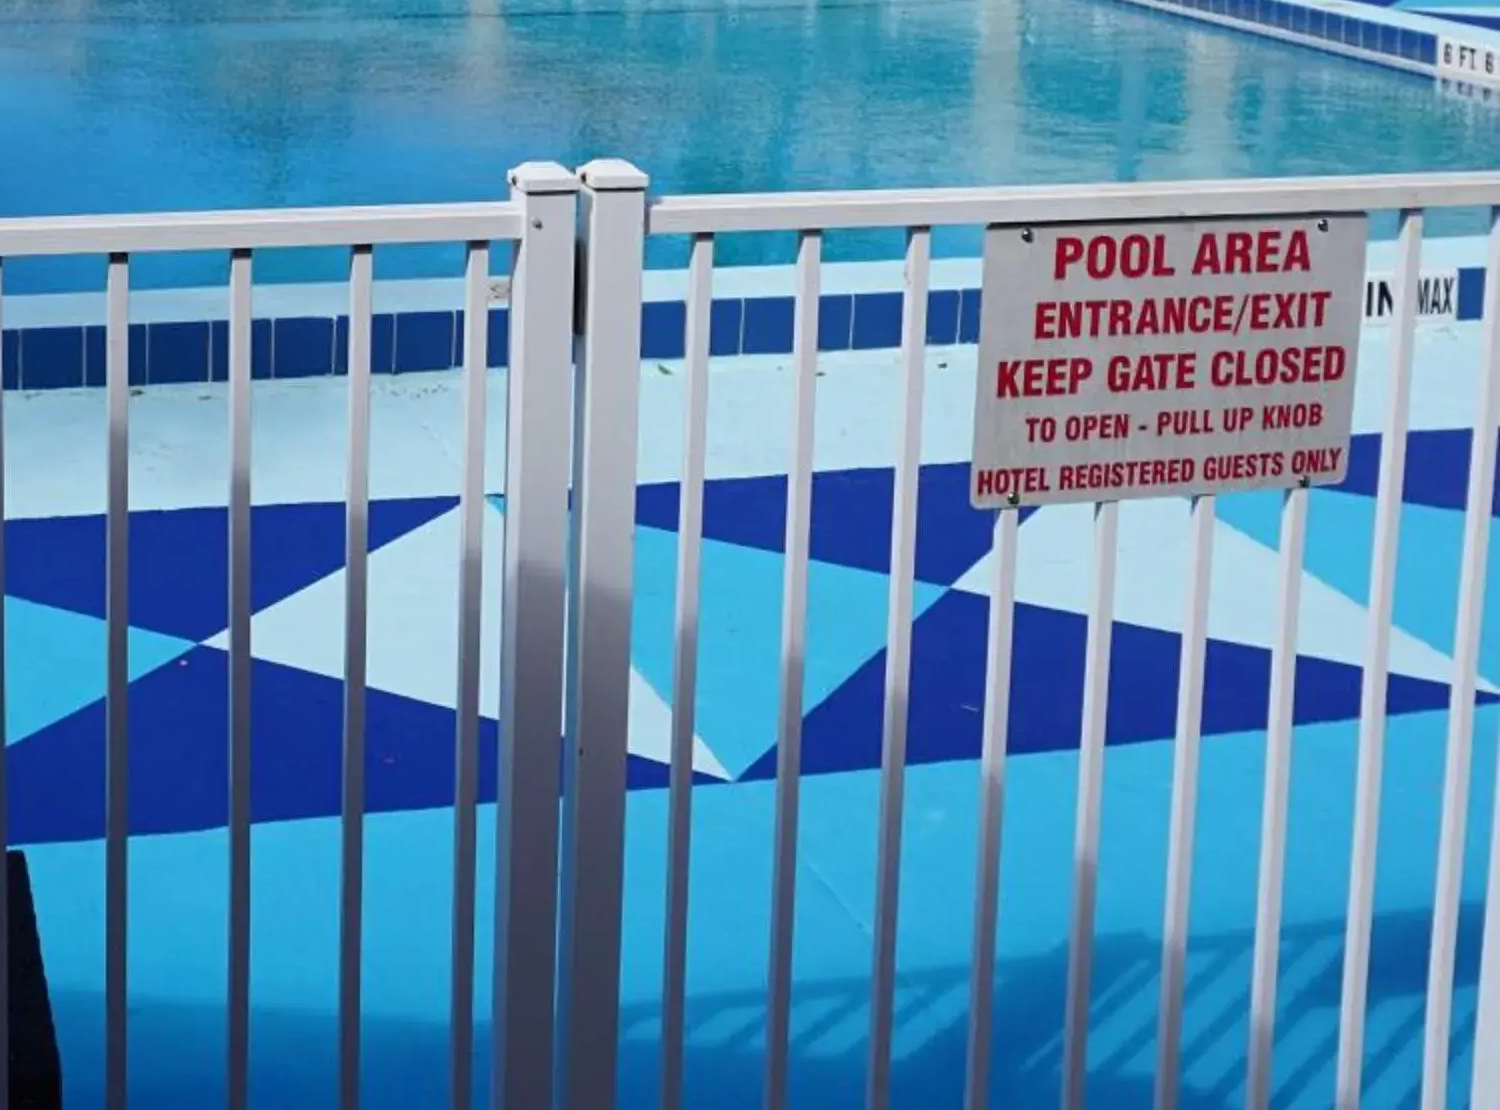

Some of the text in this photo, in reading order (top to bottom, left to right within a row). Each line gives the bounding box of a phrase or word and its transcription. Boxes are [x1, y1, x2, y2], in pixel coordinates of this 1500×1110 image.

[1459, 45, 1476, 70] FT
[1054, 230, 1312, 280] POOL AREA
[1034, 291, 1332, 340] ENTRANCE/EXIT
[1417, 277, 1454, 314] MAX
[996, 345, 1346, 398] KEEP GATE CLOSED
[1025, 417, 1056, 442] TO
[1065, 413, 1129, 441] OPEN
[1156, 410, 1214, 436] PULL
[1223, 407, 1254, 433] UP
[1262, 403, 1323, 431] KNOB
[977, 447, 1342, 495] HOTEL REGISTERED GUESTS ONLY
